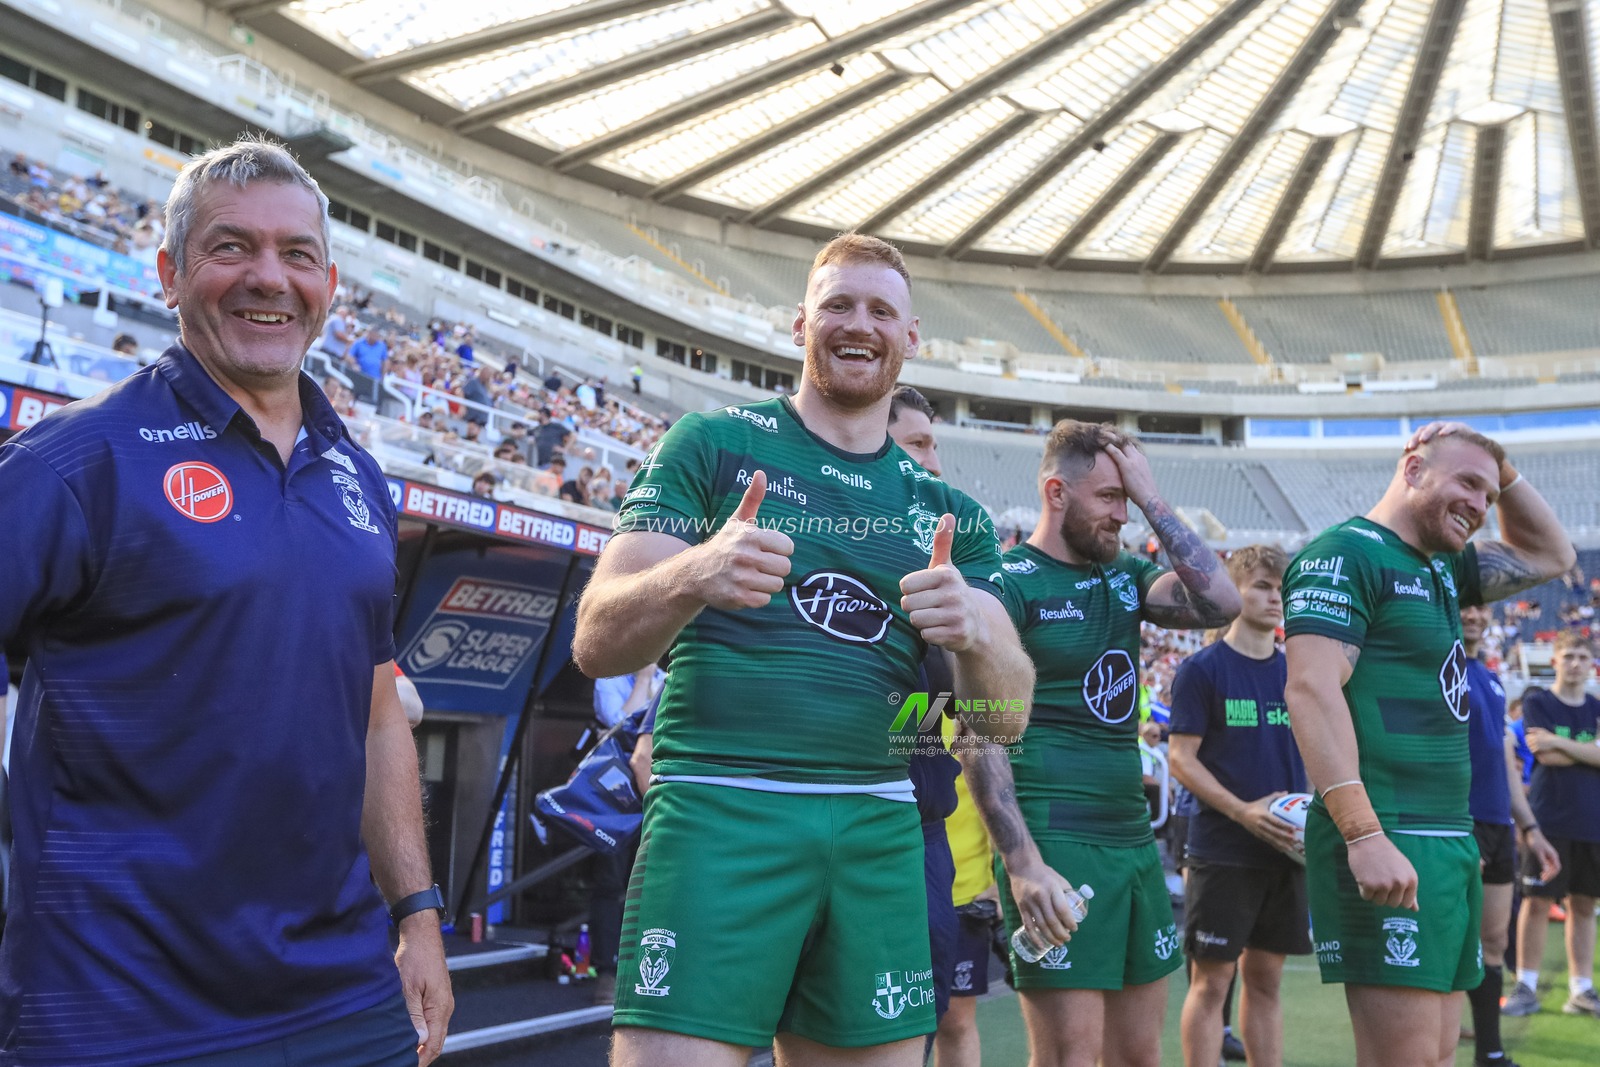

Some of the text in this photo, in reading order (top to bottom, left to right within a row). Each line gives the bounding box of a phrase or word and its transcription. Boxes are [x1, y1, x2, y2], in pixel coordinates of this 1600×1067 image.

[725, 406, 778, 429] RAM
[172, 467, 225, 516] HOOVER
[736, 469, 808, 506] Reulting
[407, 487, 495, 528] BETFRED
[498, 509, 575, 546] BETFRED
[448, 584, 559, 618] BETFRED
[1290, 590, 1348, 604] BETFRED
[1039, 608, 1084, 620] Resulting
[1310, 603, 1347, 619] LEAGUE
[461, 630, 532, 657] SUPER
[446, 651, 519, 674] LEAGUE
[1089, 660, 1134, 718] HOOVER
[1225, 699, 1258, 720] MAGIC
[642, 928, 677, 938] WARRINGTON
[646, 936, 668, 944] WOLVES
